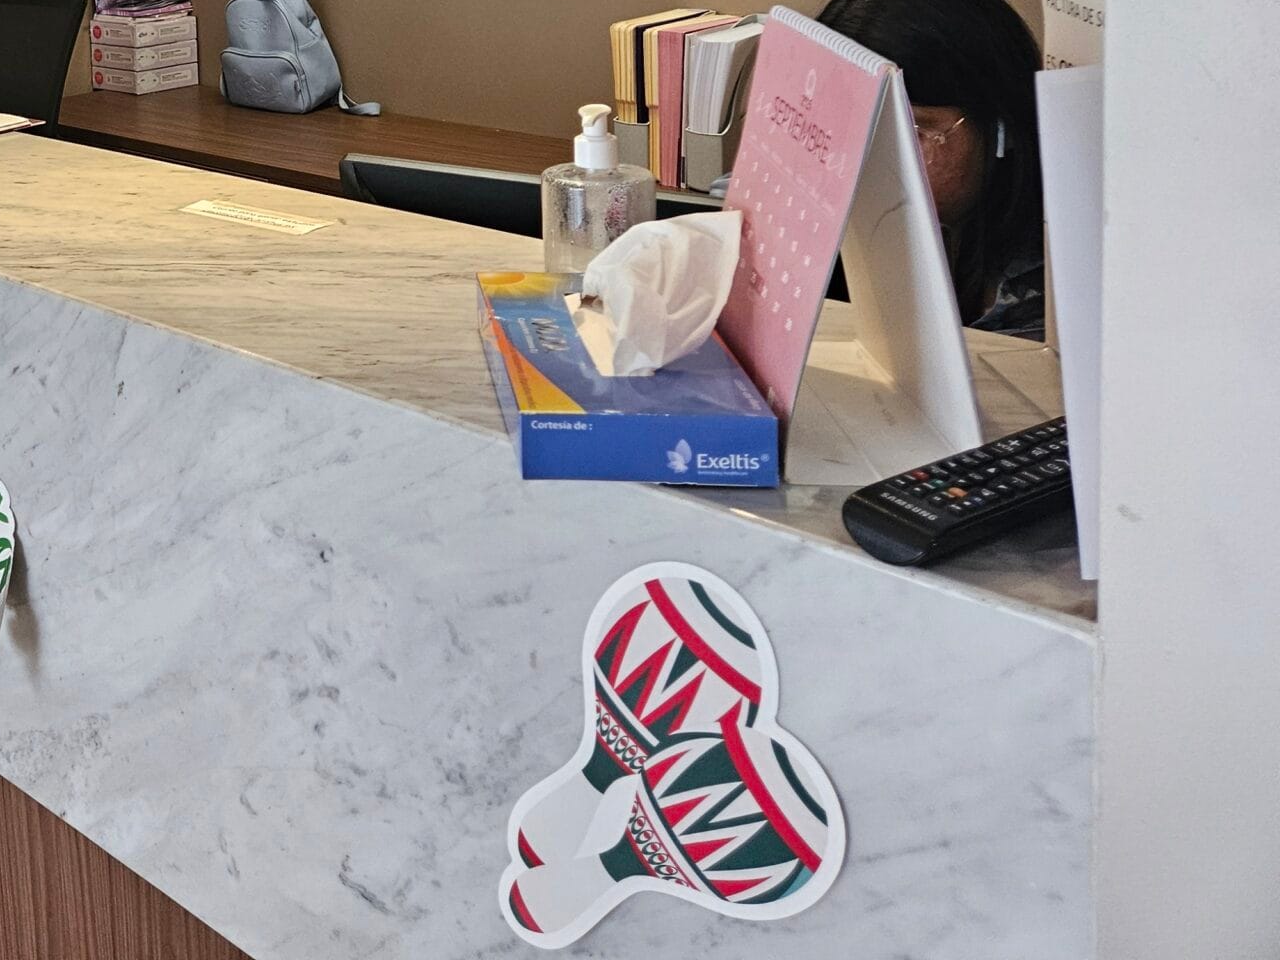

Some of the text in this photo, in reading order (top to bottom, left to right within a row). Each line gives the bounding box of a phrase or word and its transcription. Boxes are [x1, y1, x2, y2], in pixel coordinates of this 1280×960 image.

[1082, 6, 1094, 25] DE
[771, 96, 831, 163] SEPTIEMBRE
[881, 492, 938, 520] SAMSUNG
